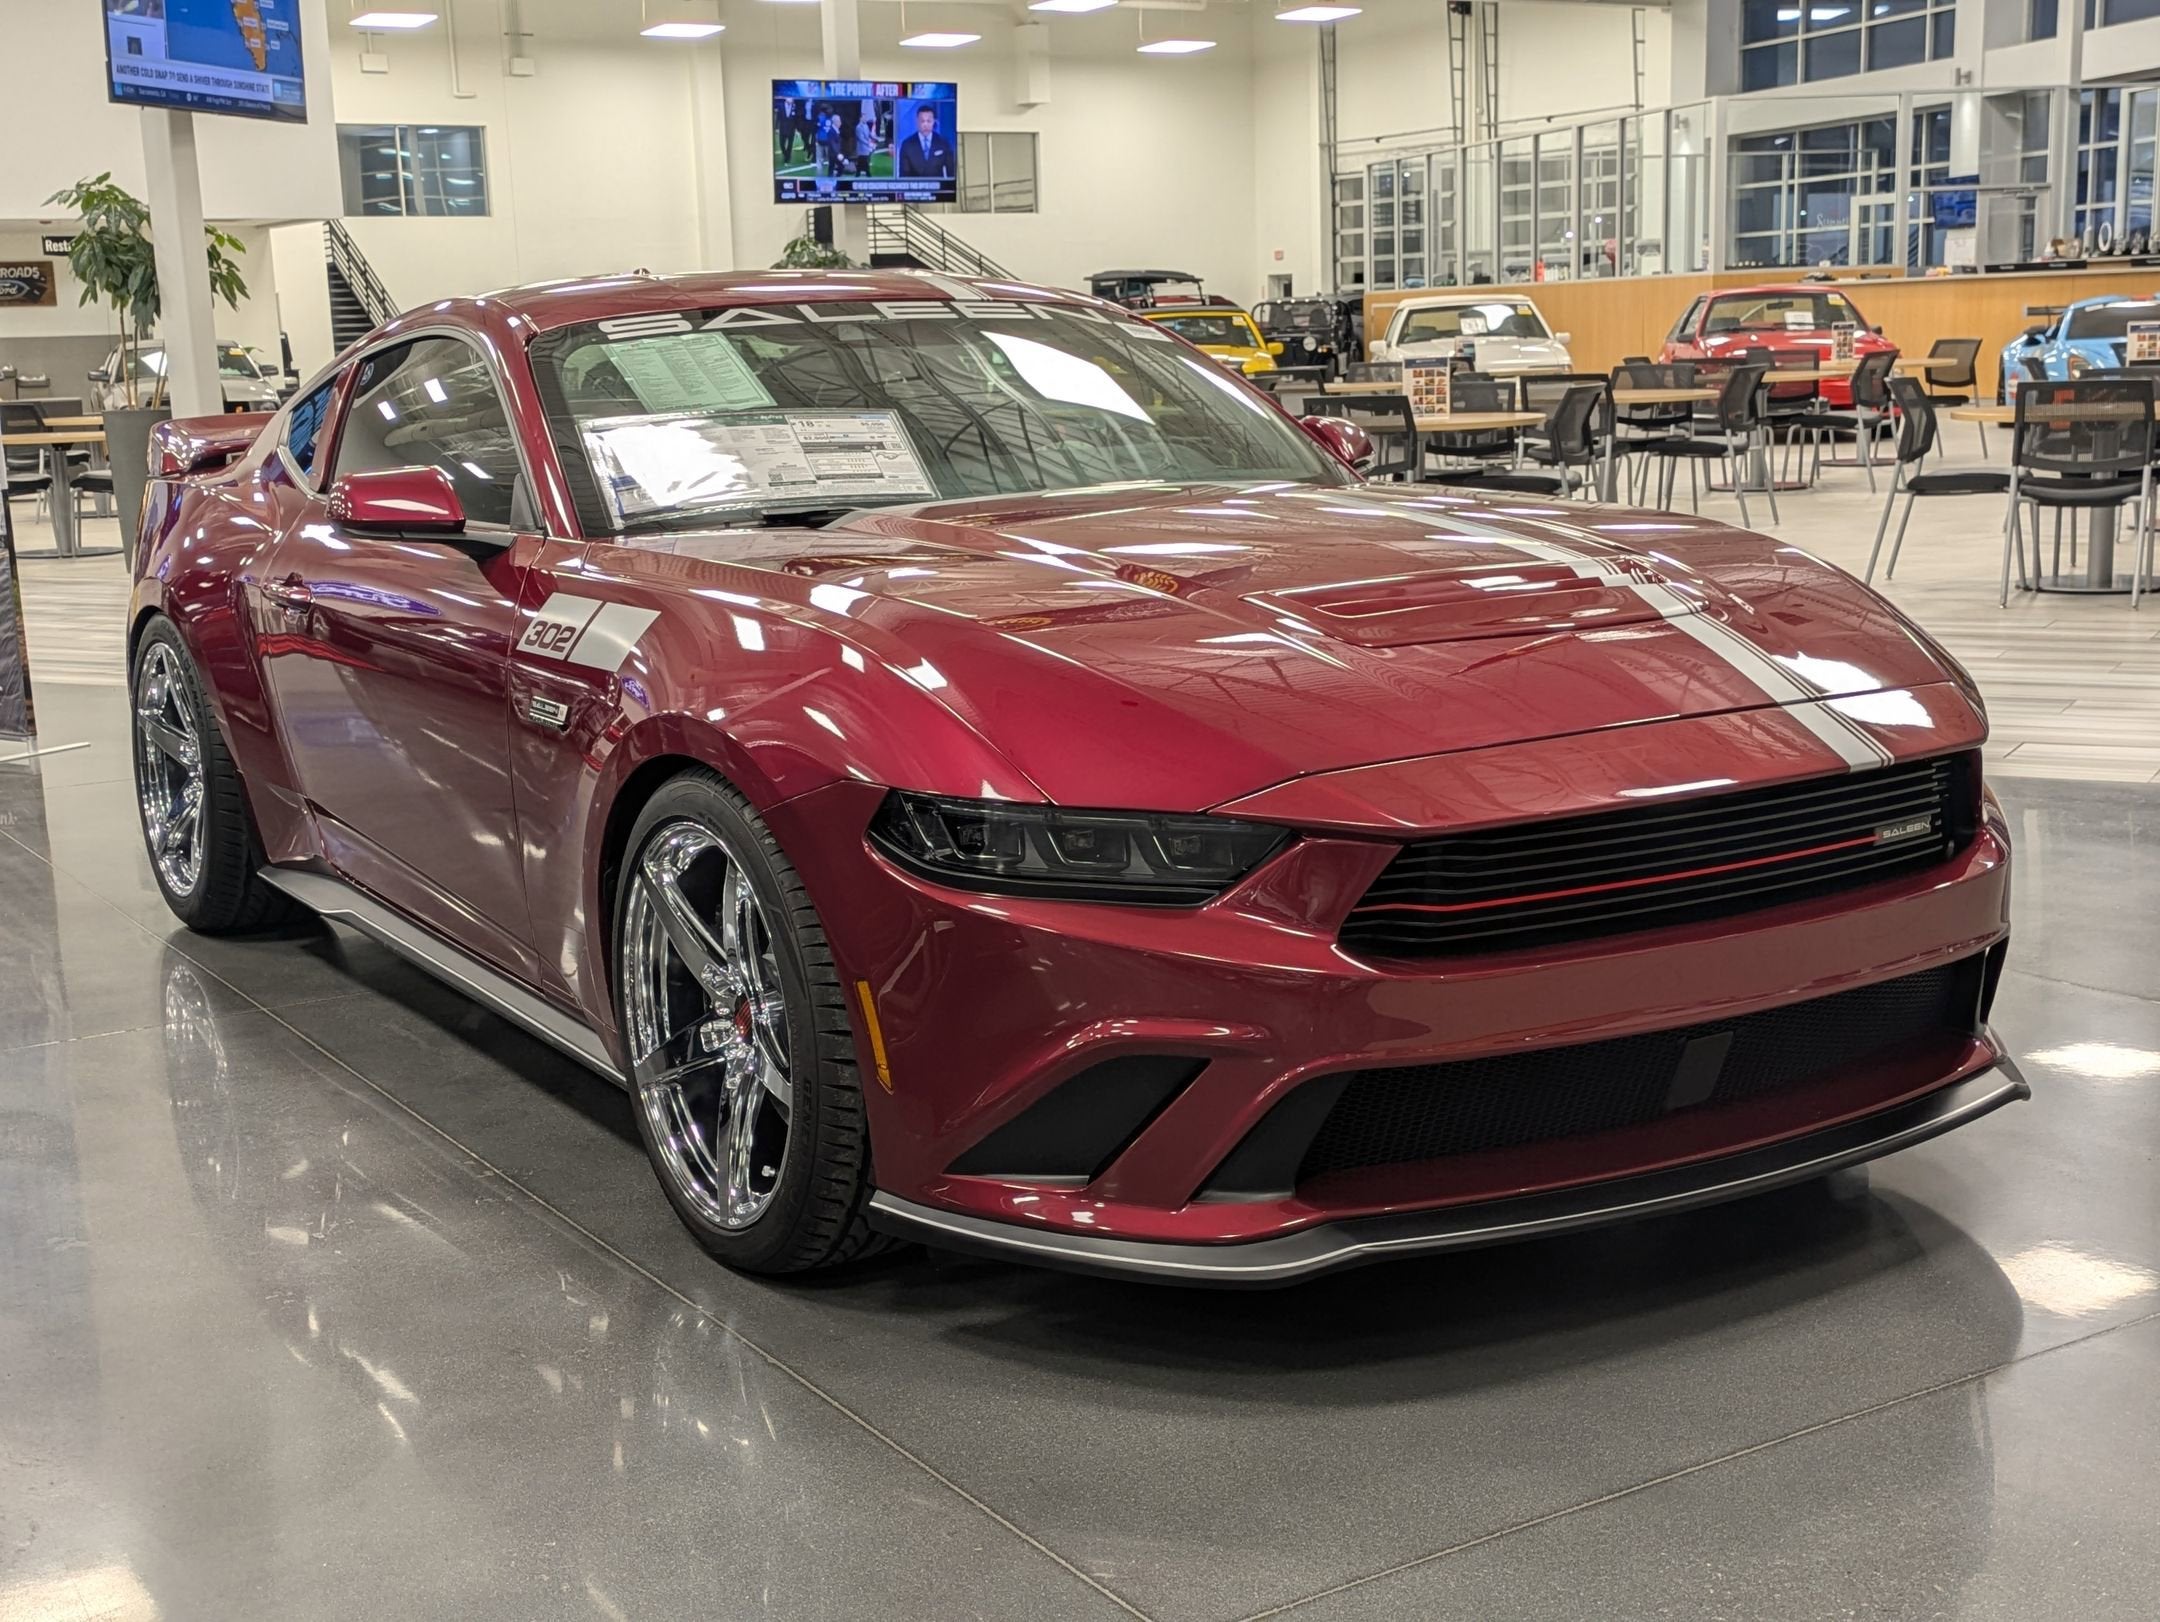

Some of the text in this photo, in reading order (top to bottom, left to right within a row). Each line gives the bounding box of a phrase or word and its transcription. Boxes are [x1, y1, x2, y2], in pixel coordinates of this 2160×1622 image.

[829, 83, 899, 97] THE POINT AFTER
[597, 301, 1112, 340] SALEEN
[524, 621, 577, 652] 302
[1882, 821, 1930, 839] SALEEN
